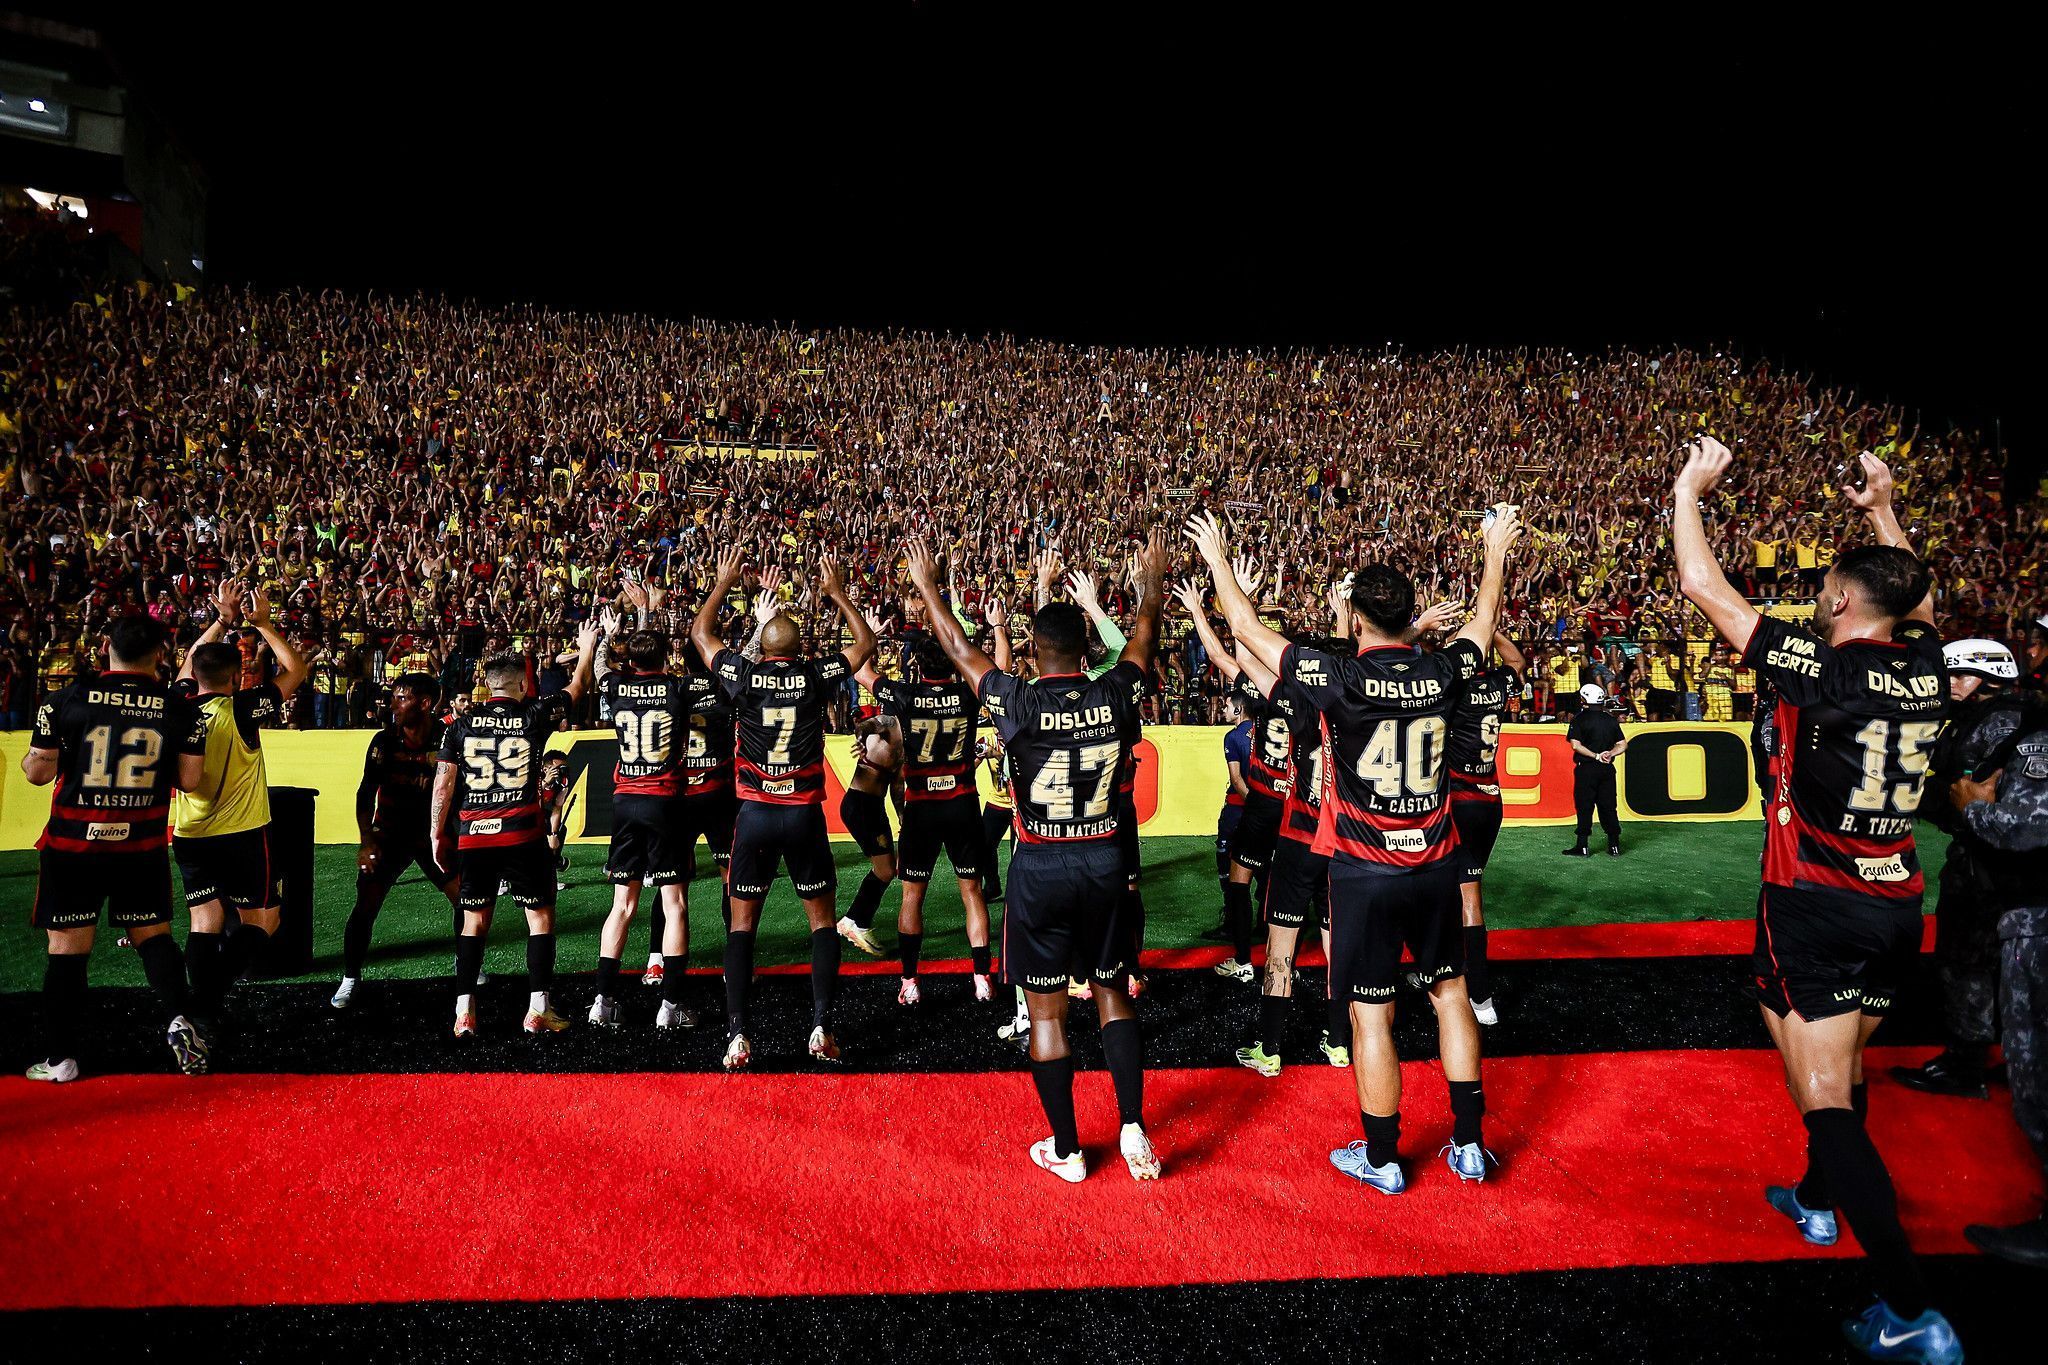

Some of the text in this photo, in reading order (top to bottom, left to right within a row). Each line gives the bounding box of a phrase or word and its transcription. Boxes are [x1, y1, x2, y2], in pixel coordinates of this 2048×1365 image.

[1782, 635, 1816, 657] VIVA
[824, 662, 840, 671] VIVA
[1767, 651, 1822, 678] SORTE
[618, 684, 666, 697] DISLUB
[752, 675, 806, 690] DISLUB
[1365, 679, 1441, 698] DISLUB
[88, 691, 164, 709] DISLUB
[121, 709, 163, 719] energia
[472, 717, 522, 728] DISLUB
[1041, 706, 1113, 731] DISLUB
[615, 710, 673, 763] 30
[762, 706, 796, 764] 7
[910, 717, 968, 763] 77
[1073, 725, 1116, 740] energia
[82, 725, 163, 788] 12
[464, 737, 530, 790] 59
[1357, 715, 1447, 797] 40
[1848, 719, 1940, 812] 15
[764, 783, 793, 792] Iquine
[929, 779, 954, 788] Iquine
[1030, 740, 1121, 820] 47
[78, 793, 88, 805] A.
[1369, 794, 1439, 814] L. CASTAN
[471, 822, 500, 831] Iquine
[1066, 816, 1118, 838] MATHEUS
[1839, 813, 1857, 832] R.
[89, 827, 128, 838] Iquine
[1388, 836, 1423, 849] Iquine
